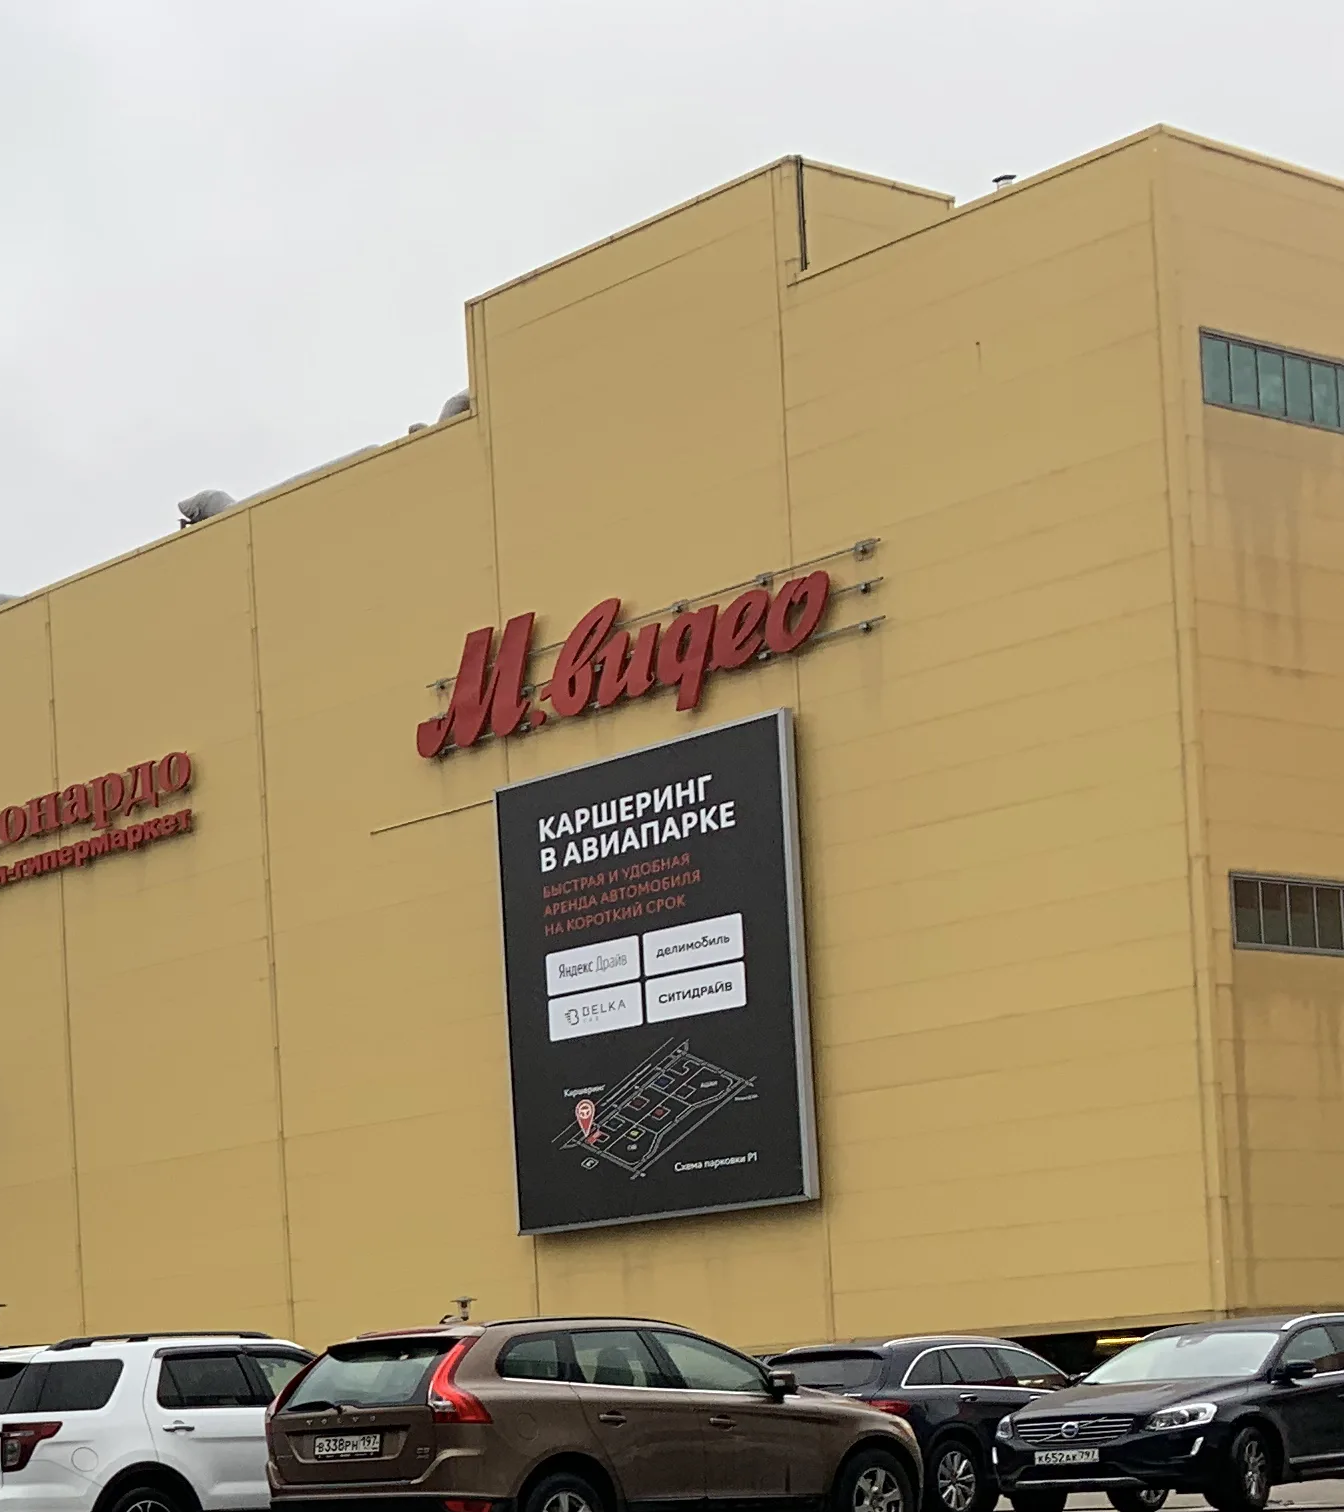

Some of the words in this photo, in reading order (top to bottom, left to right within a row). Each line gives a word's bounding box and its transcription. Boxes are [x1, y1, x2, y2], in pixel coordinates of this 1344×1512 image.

[417, 570, 830, 758] М.видео
[538, 774, 712, 842] КАРШЕРИНГ
[541, 847, 557, 872] В
[563, 801, 736, 867] АВИАПАРКЕ
[543, 872, 605, 899] БЫСТРАЯ
[609, 869, 618, 884] И
[622, 852, 691, 880] УДОБНАЯ
[544, 895, 597, 917] АРЕНДА
[600, 869, 702, 905] АВТОМОБИЛЯ
[545, 921, 564, 936] НА
[566, 902, 643, 931] КОРОТКИЙ
[646, 894, 687, 914] СРОК
[559, 961, 594, 979] Яндекс
[595, 954, 628, 973] Драйв
[656, 935, 731, 959] делимобиль
[658, 980, 733, 1004] СИТИДРАЙВ
[674, 1161, 703, 1172] Схема
[703, 1155, 746, 1169] парковки
